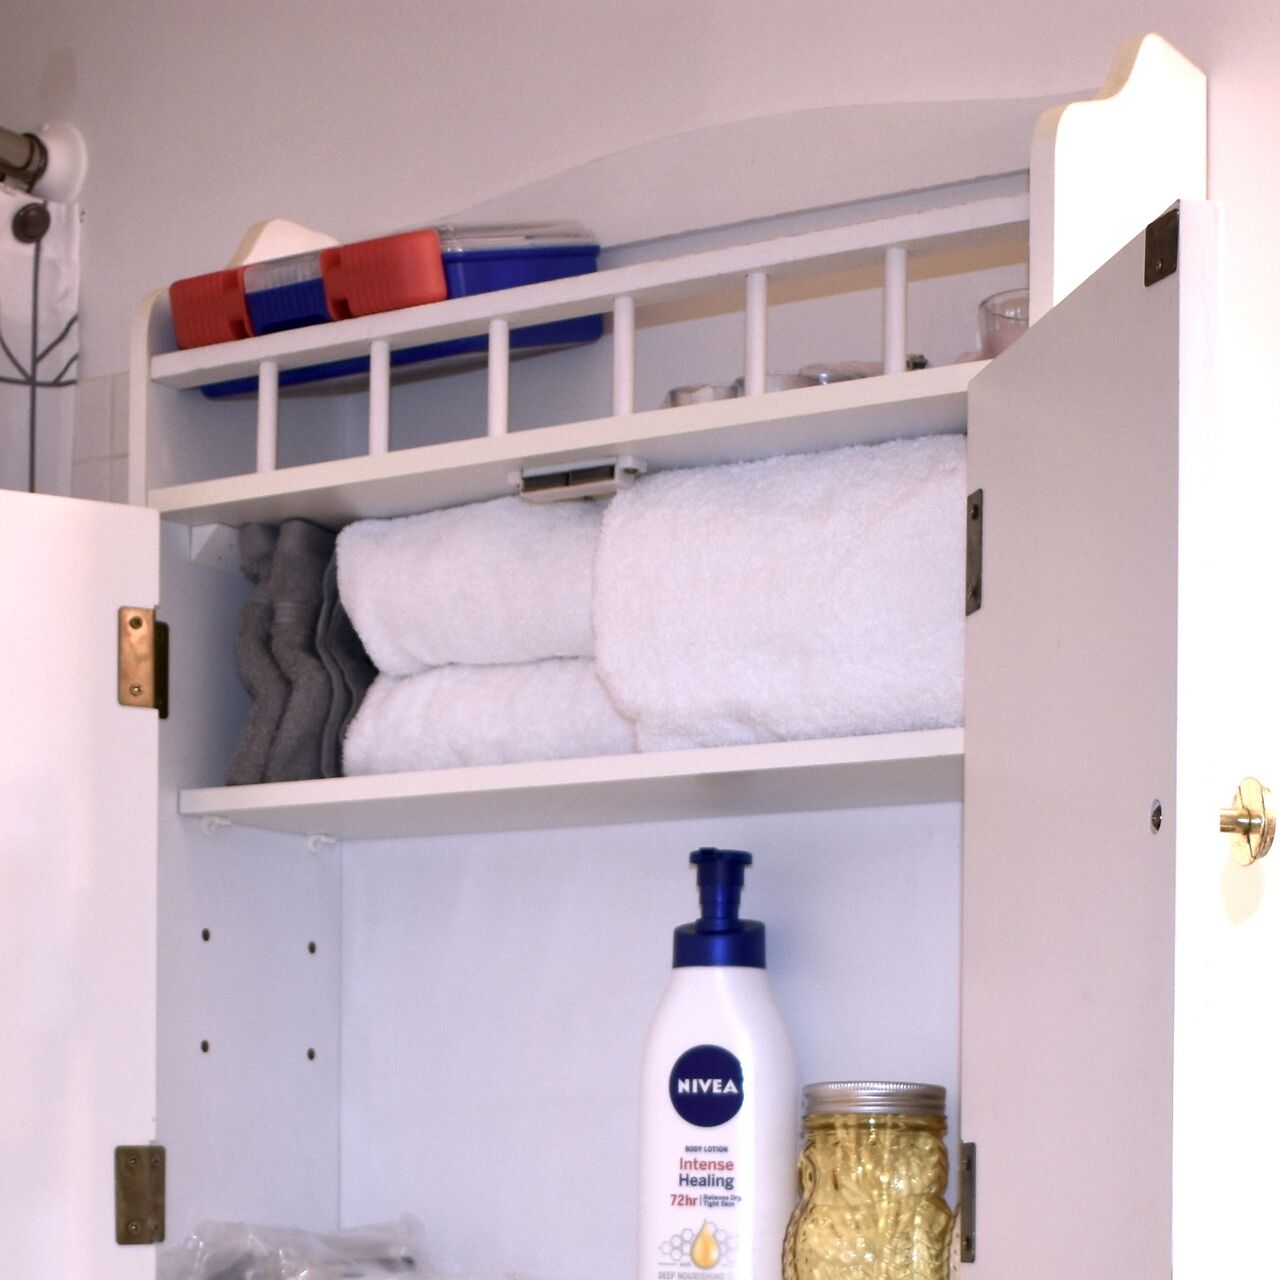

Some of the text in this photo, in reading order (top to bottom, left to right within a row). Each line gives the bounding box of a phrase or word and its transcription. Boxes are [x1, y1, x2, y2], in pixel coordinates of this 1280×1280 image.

[678, 1078, 738, 1093] NIVEA
[685, 1145, 729, 1153] BODY LOTION
[679, 1156, 734, 1171] Intense
[678, 1173, 735, 1191] Healing
[670, 1193, 698, 1206] 72hr
[658, 1271, 676, 1280] DEEP
